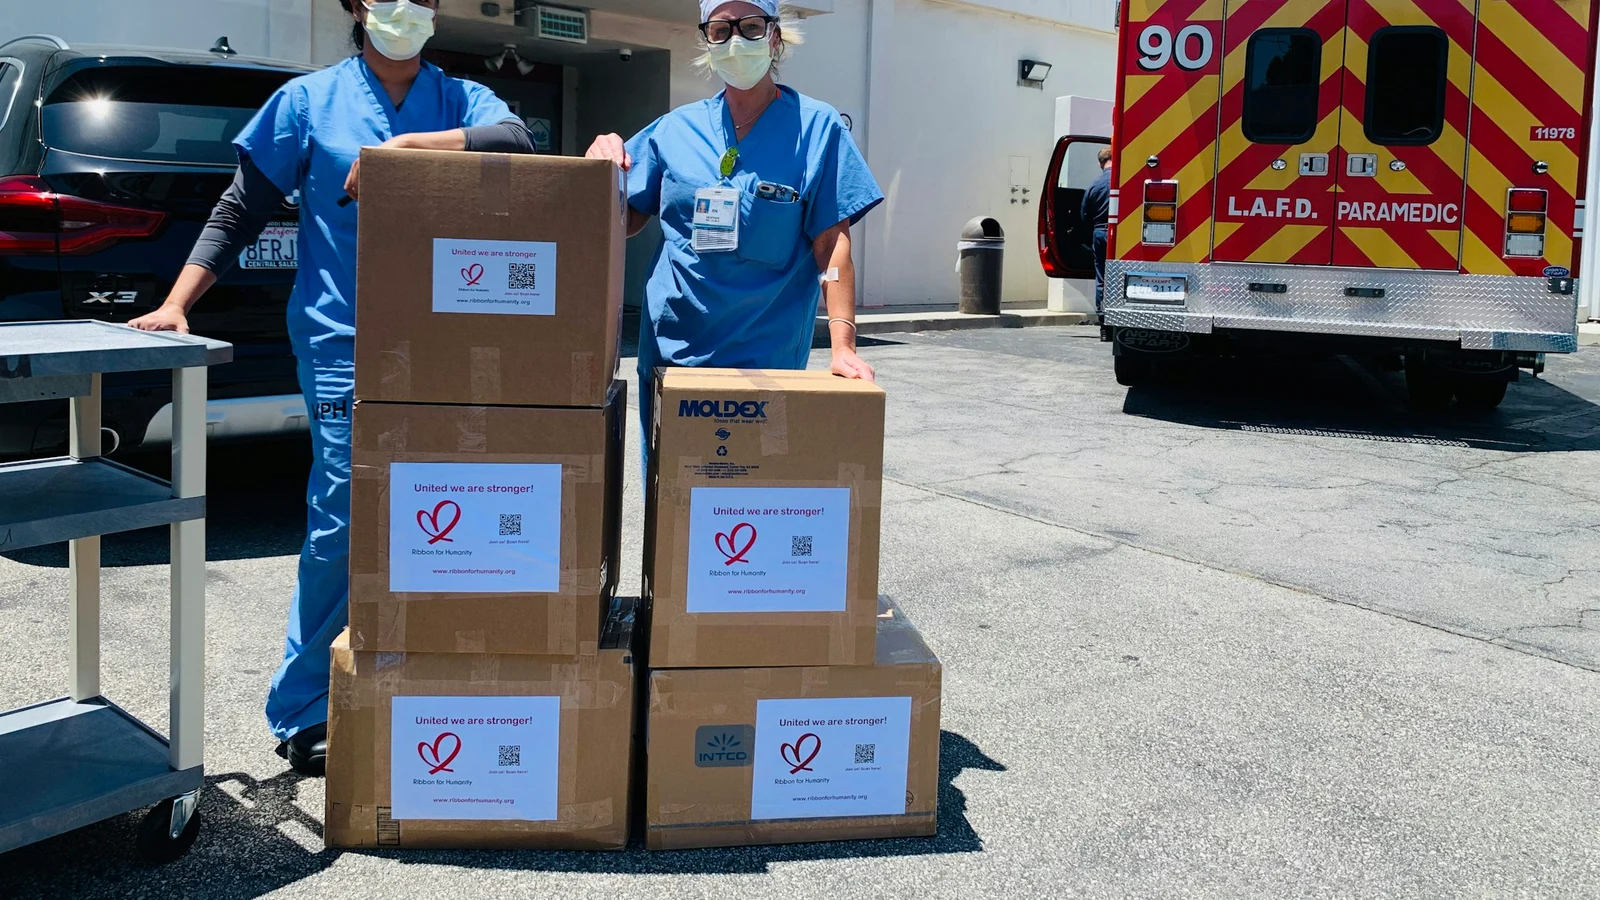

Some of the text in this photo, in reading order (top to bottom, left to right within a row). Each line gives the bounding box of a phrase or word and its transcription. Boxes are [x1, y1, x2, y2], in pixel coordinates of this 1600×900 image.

[1136, 24, 1214, 71] 90
[1535, 128, 1575, 139] 11978
[1228, 196, 1458, 224] L.A.F.D. PARAMEDIC
[82, 291, 138, 303] X3
[1125, 330, 1181, 340] NORTH
[678, 400, 767, 418] MOLDEX
[414, 484, 448, 492] United
[487, 484, 534, 494] stronger!
[713, 507, 744, 515] United
[780, 507, 824, 517] stronger!
[415, 716, 448, 725] United
[487, 716, 532, 726] stronger!
[779, 718, 810, 727] United
[845, 717, 887, 727] stronger!
[699, 752, 747, 762] INTCO
[792, 794, 868, 802] www.ribbonforhumanity.org
